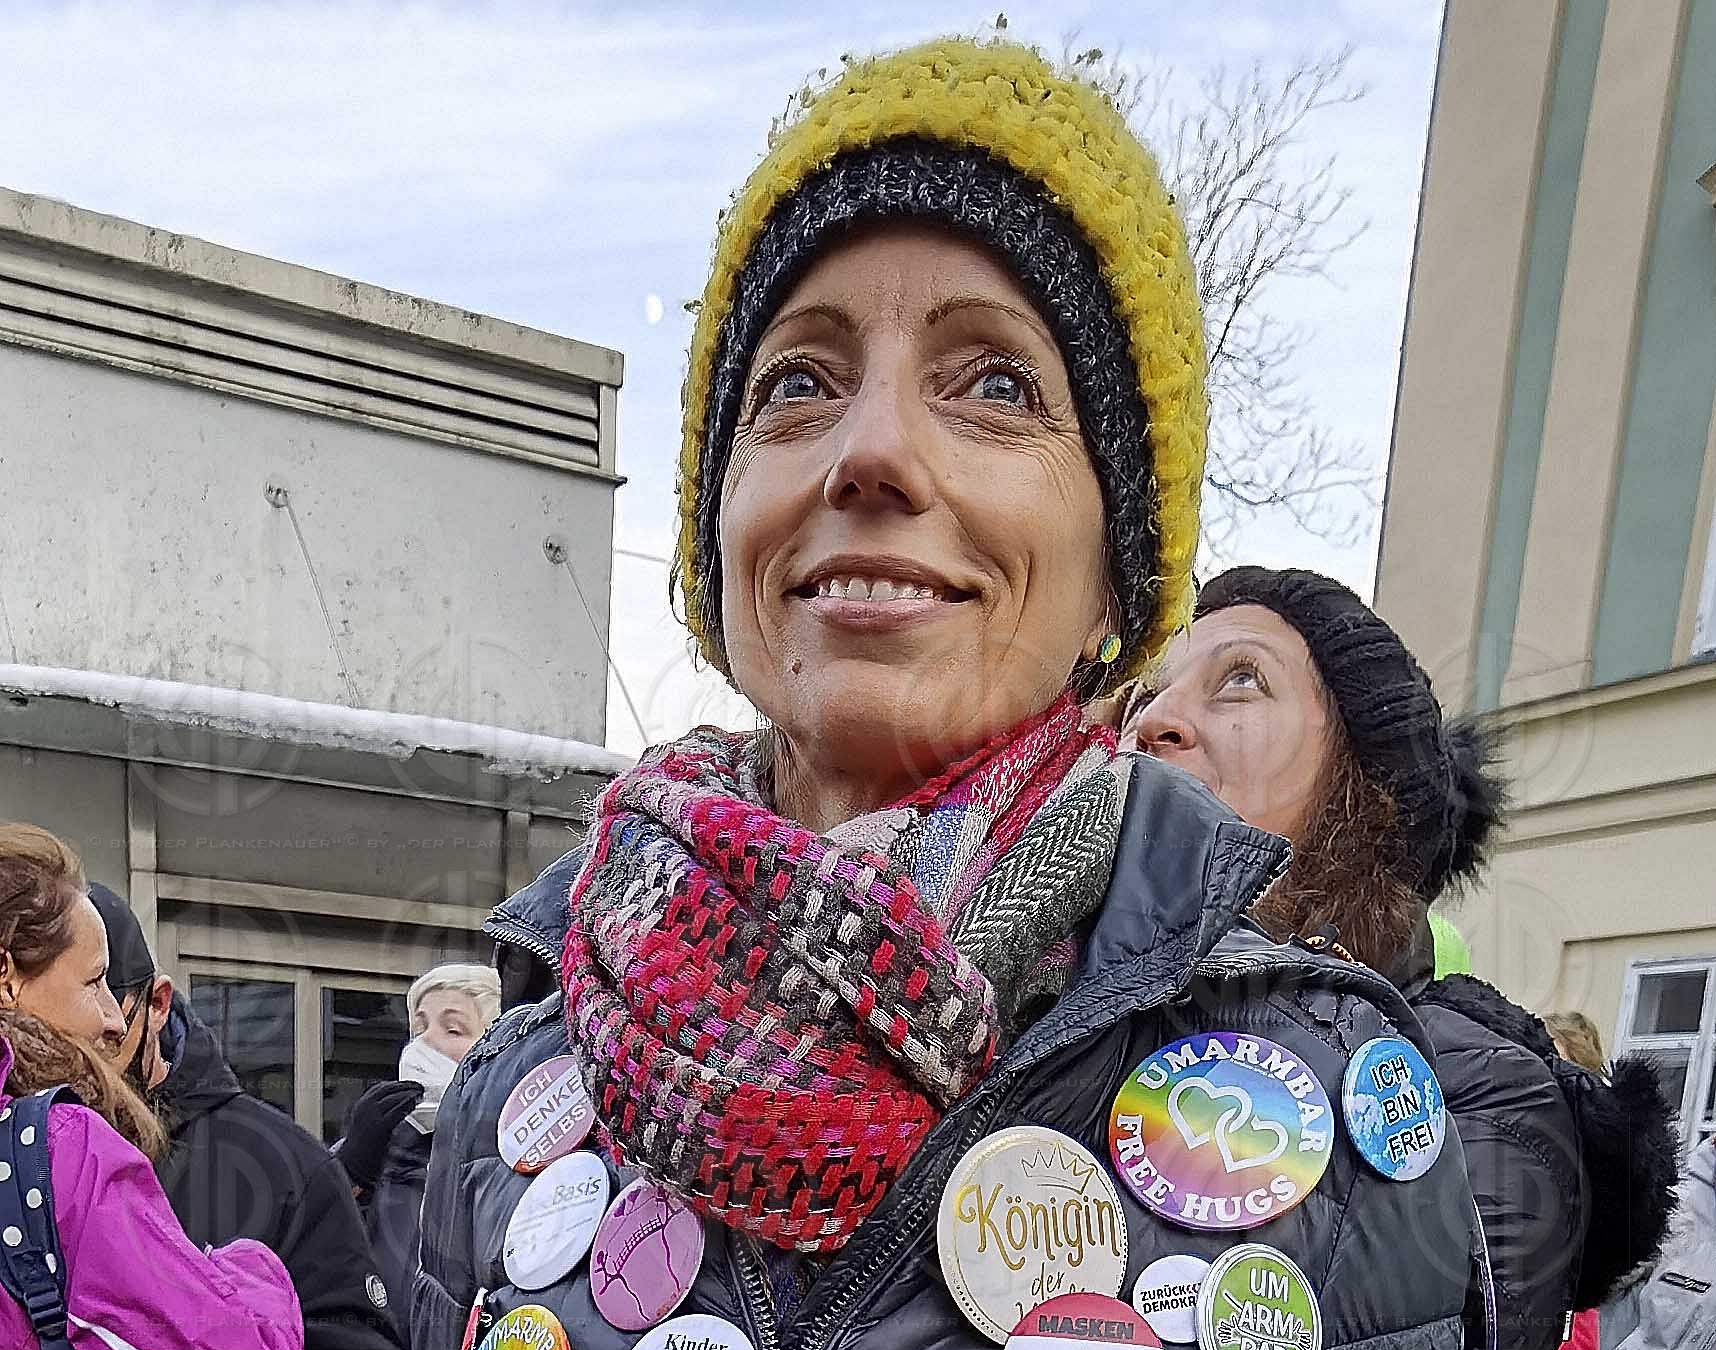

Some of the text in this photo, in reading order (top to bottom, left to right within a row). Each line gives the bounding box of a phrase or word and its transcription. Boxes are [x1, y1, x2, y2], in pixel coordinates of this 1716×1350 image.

[518, 1070, 553, 1107] ICH
[1371, 1056, 1408, 1090] ICH
[514, 1074, 581, 1146] DENKE
[1136, 1038, 1327, 1153] UMARMBAR
[1383, 1089, 1420, 1124] BIN
[1387, 1121, 1435, 1162] FREI
[1116, 1113, 1297, 1222] FREE HUGS
[956, 1183, 1121, 1271] Königin
[1031, 1262, 1065, 1300] der
[1250, 1267, 1288, 1303] UM
[1038, 1314, 1135, 1340] MASKEN
[1238, 1301, 1295, 1340] ARM
